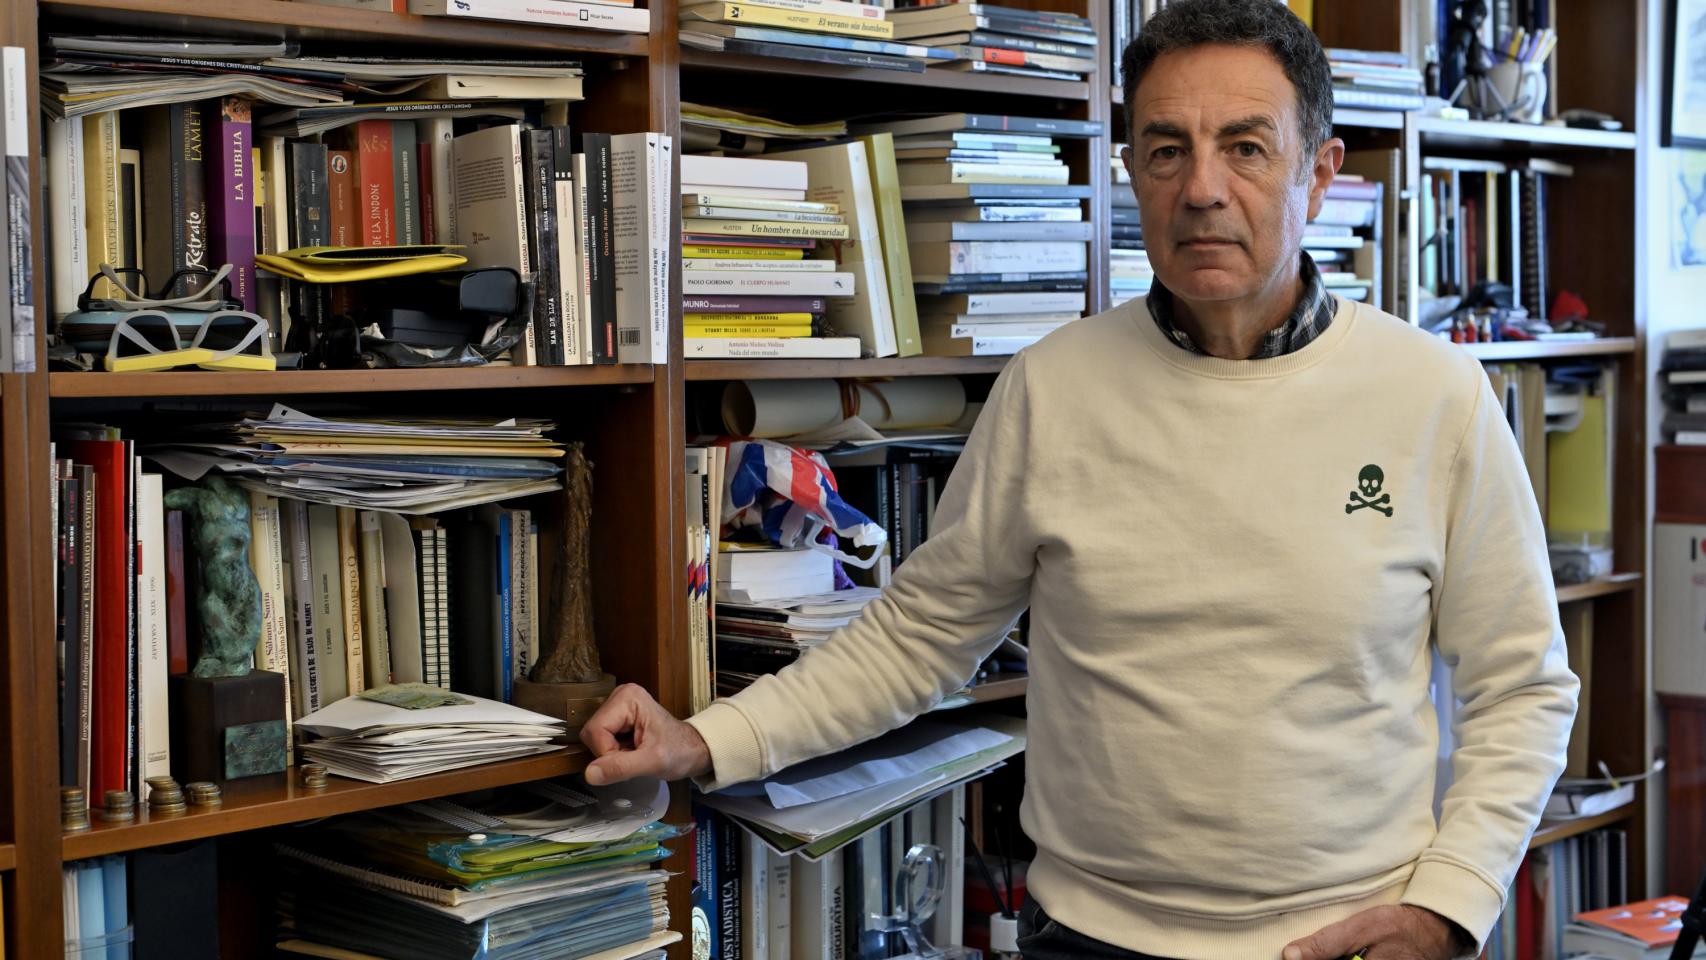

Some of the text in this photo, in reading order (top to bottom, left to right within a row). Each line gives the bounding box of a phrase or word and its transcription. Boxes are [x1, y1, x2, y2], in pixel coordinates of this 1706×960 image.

[828, 21, 848, 29] verano
[861, 24, 889, 32] hombres
[190, 108, 202, 161] LAMET
[233, 131, 244, 200] LA BIBLIA
[370, 184, 382, 245] DE LA SINDONE
[752, 224, 762, 232] Un
[763, 225, 790, 234] hombre
[809, 228, 845, 236] oscuridad
[107, 228, 118, 240] DE
[186, 211, 208, 271] Retrato
[549, 317, 556, 327] DE
[84, 530, 91, 543] DE
[83, 592, 90, 601] EL
[351, 570, 361, 656] EL DOCUMENTO
[265, 622, 274, 656] Sábana
[305, 637, 314, 654] JESÚS
[82, 646, 90, 686] Rodríguez
[267, 658, 274, 670] La
[309, 666, 317, 693] SECRETA
[81, 688, 89, 741] Jorge-Manuel
[722, 881, 734, 960] ESTADISTICA
[834, 886, 842, 960] SIQUIATRIA
